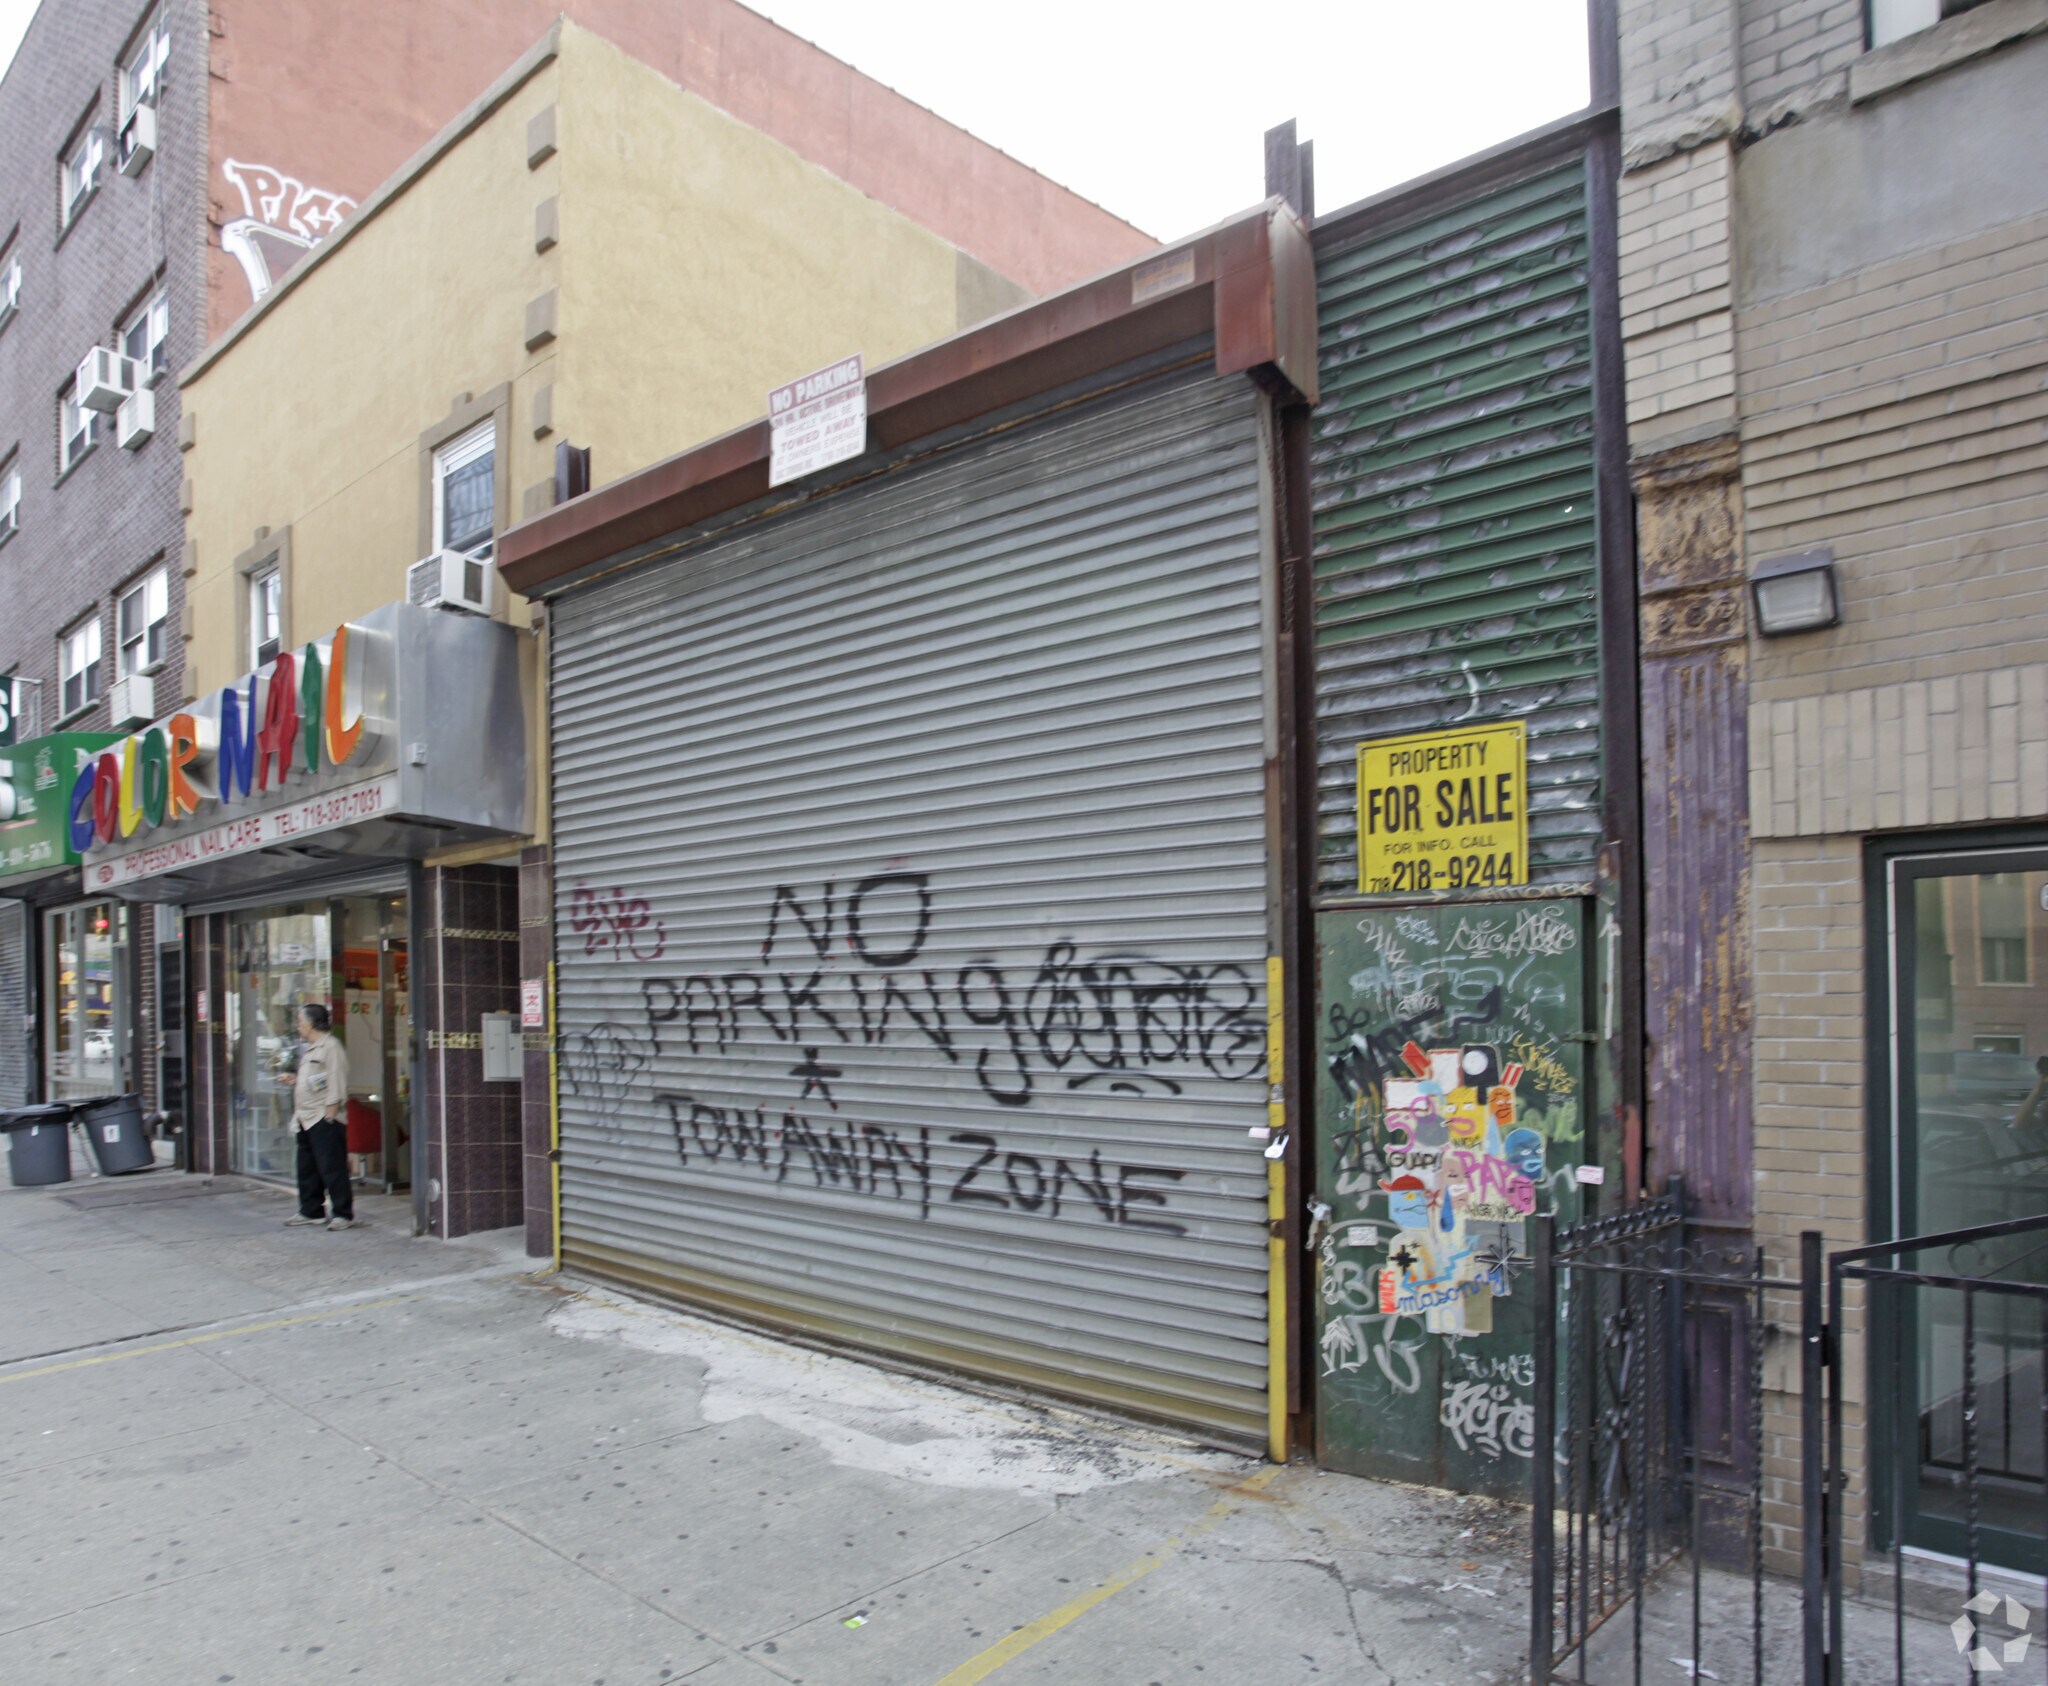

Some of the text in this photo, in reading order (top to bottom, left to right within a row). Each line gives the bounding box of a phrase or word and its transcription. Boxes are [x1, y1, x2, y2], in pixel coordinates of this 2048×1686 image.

[771, 358, 859, 415] NO PARKING
[70, 622, 366, 853] COLOR NAIL
[1388, 739, 1489, 778] PROPERTY
[1367, 772, 1514, 835] FOR SALE
[125, 837, 198, 875] PROFESSIONAL
[200, 831, 225, 856] NAIL
[228, 818, 262, 849] CARE
[1384, 841, 1413, 856] FOR
[1459, 834, 1498, 849] CALL
[1391, 852, 1514, 892] 218-9244
[762, 872, 931, 968] NO
[949, 1132, 1188, 1237] ZONE
